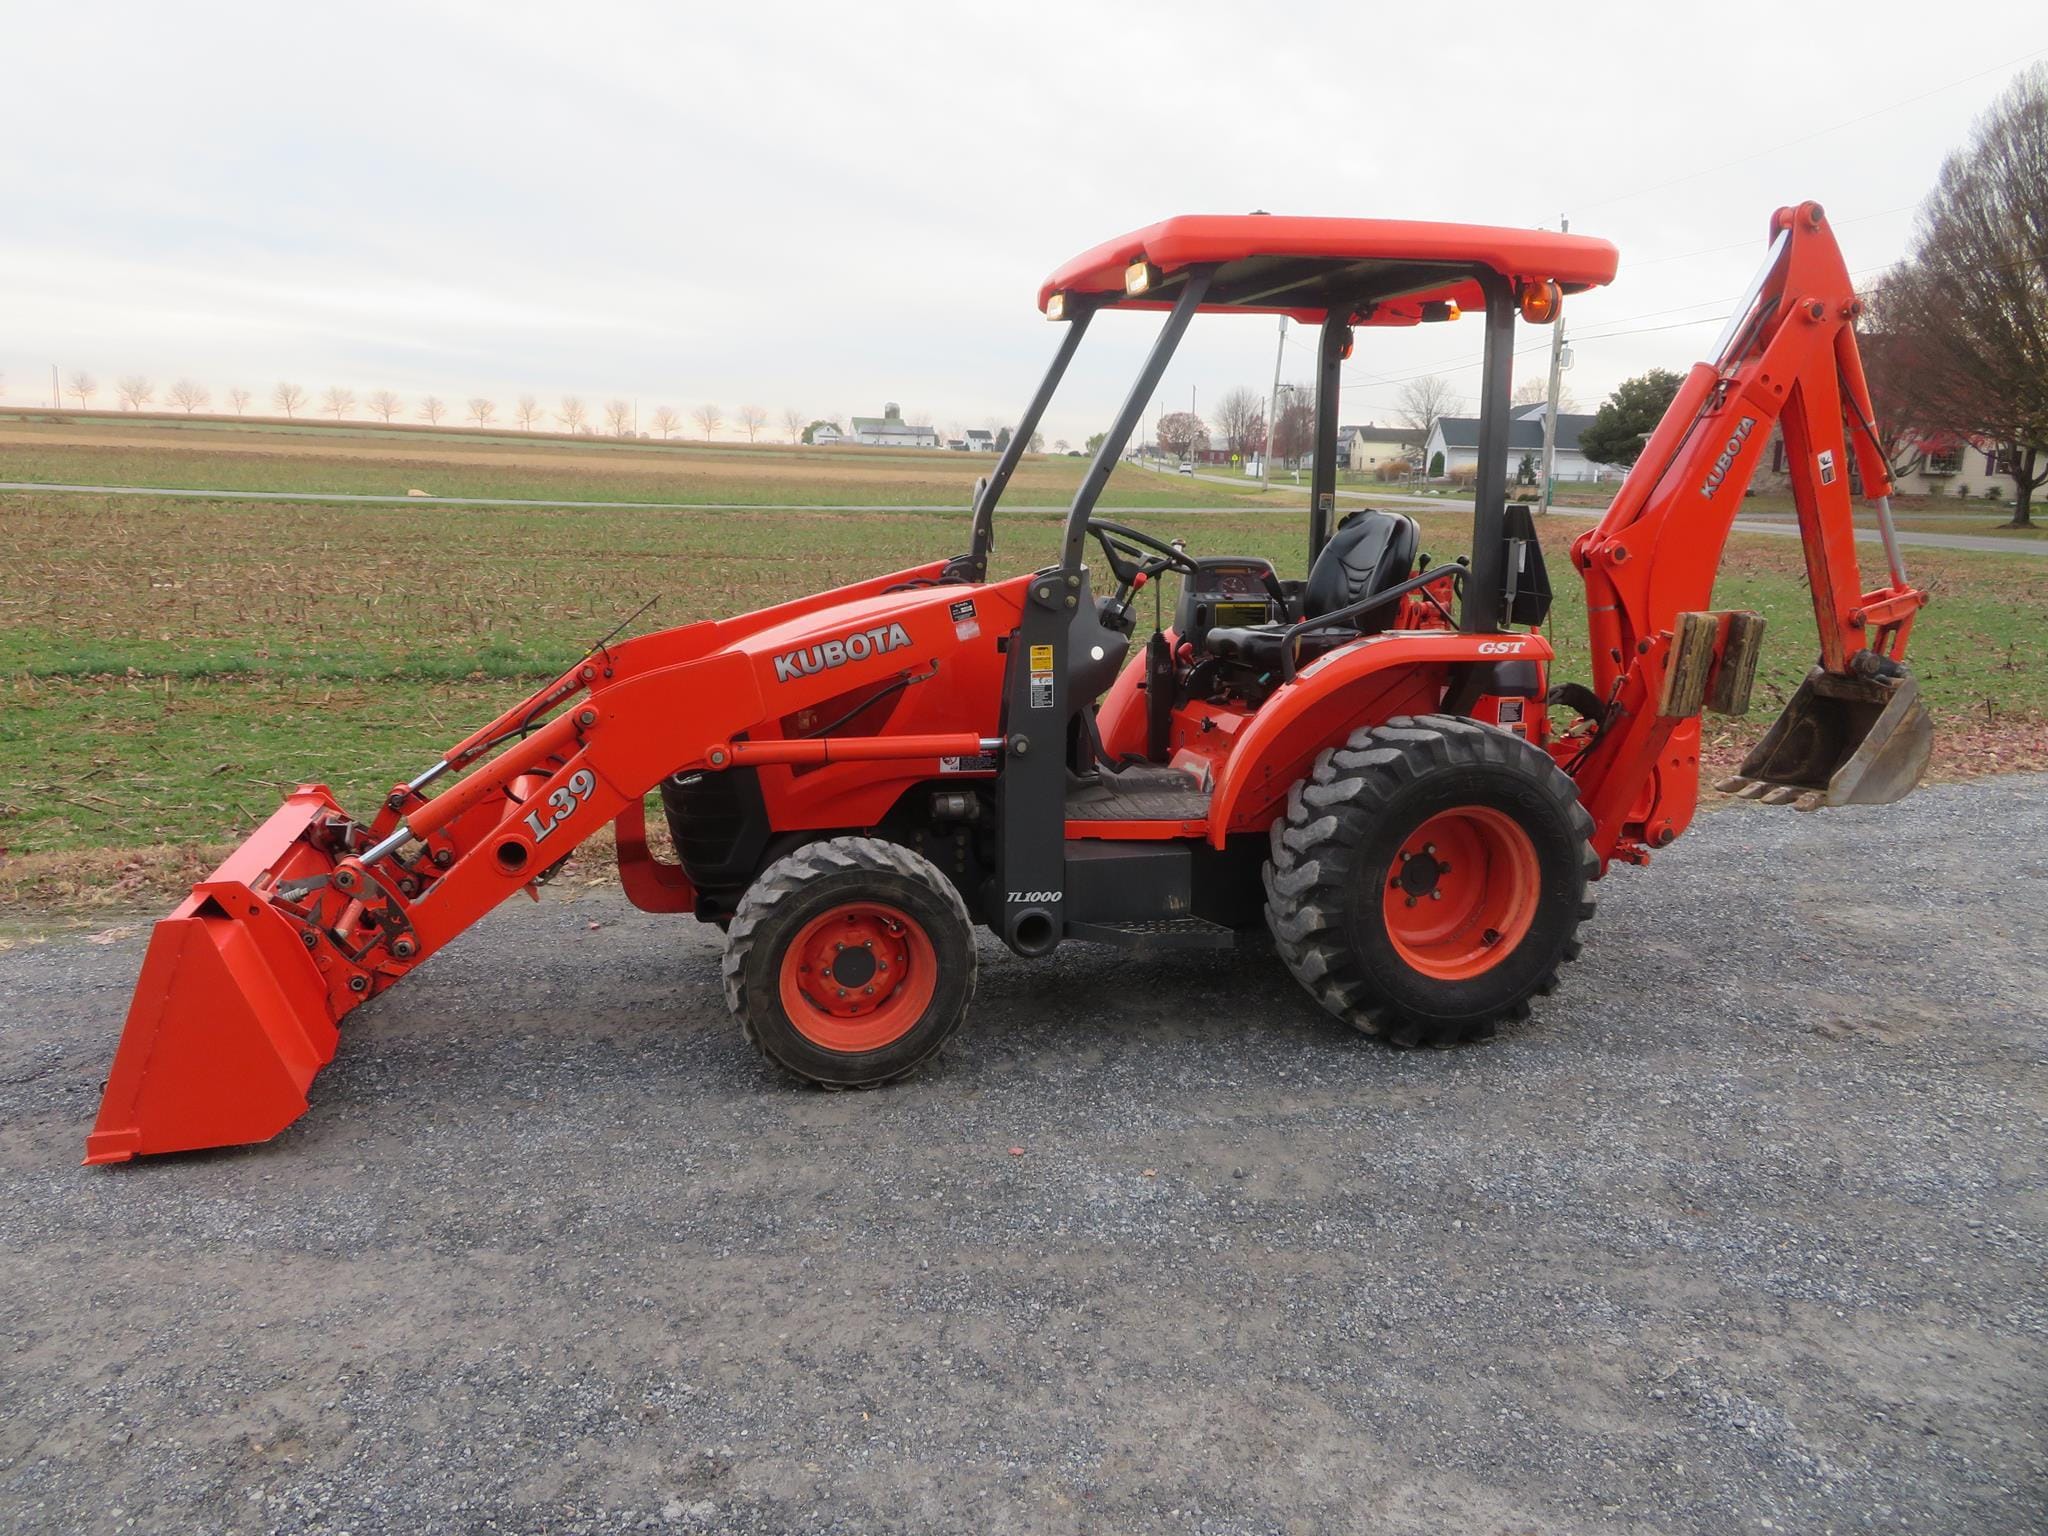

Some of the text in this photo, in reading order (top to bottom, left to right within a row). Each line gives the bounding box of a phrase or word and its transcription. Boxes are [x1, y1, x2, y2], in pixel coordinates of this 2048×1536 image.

[1701, 416, 1756, 499] KUBOTA
[773, 622, 912, 683] KUBOTA
[1478, 641, 1526, 654] GST
[523, 768, 596, 843] L39
[1007, 891, 1062, 903] TL1000
